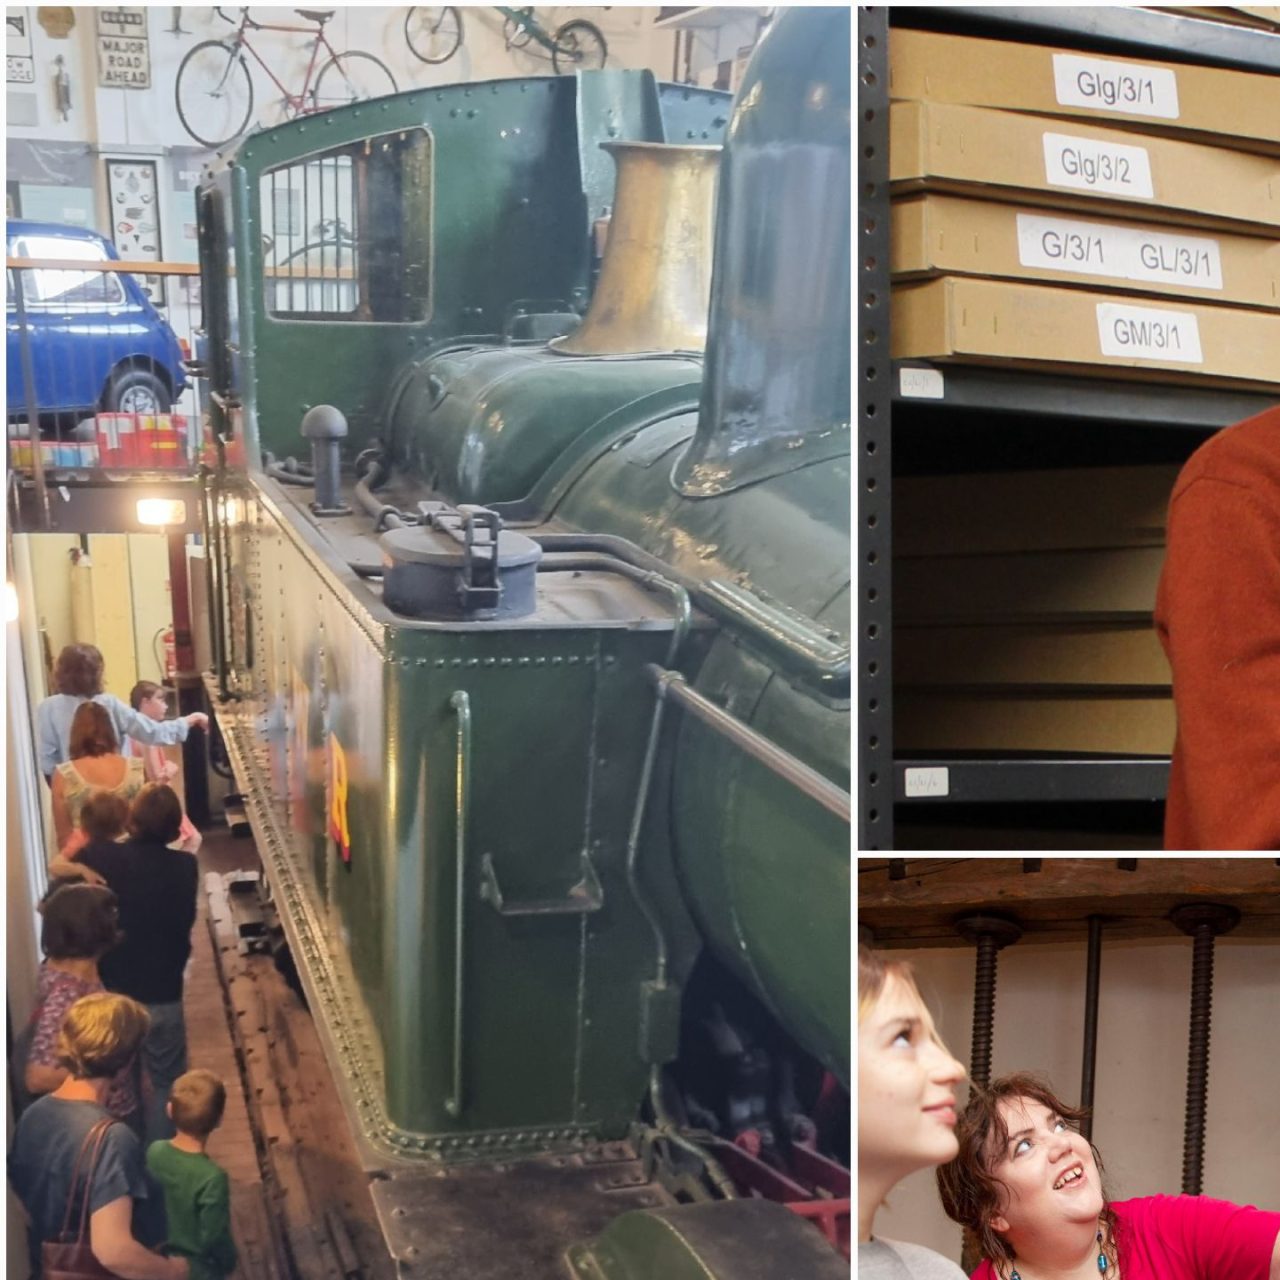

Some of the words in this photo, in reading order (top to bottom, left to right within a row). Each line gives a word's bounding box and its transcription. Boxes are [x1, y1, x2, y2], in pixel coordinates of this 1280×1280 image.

[103, 40, 145, 54] MAJOR
[109, 55, 142, 69] ROAD
[105, 71, 147, 84] AHEAD
[1041, 231, 1105, 264] G/3/1
[1140, 244, 1211, 278] GL/3/1
[1113, 318, 1181, 350] GM/3/1
